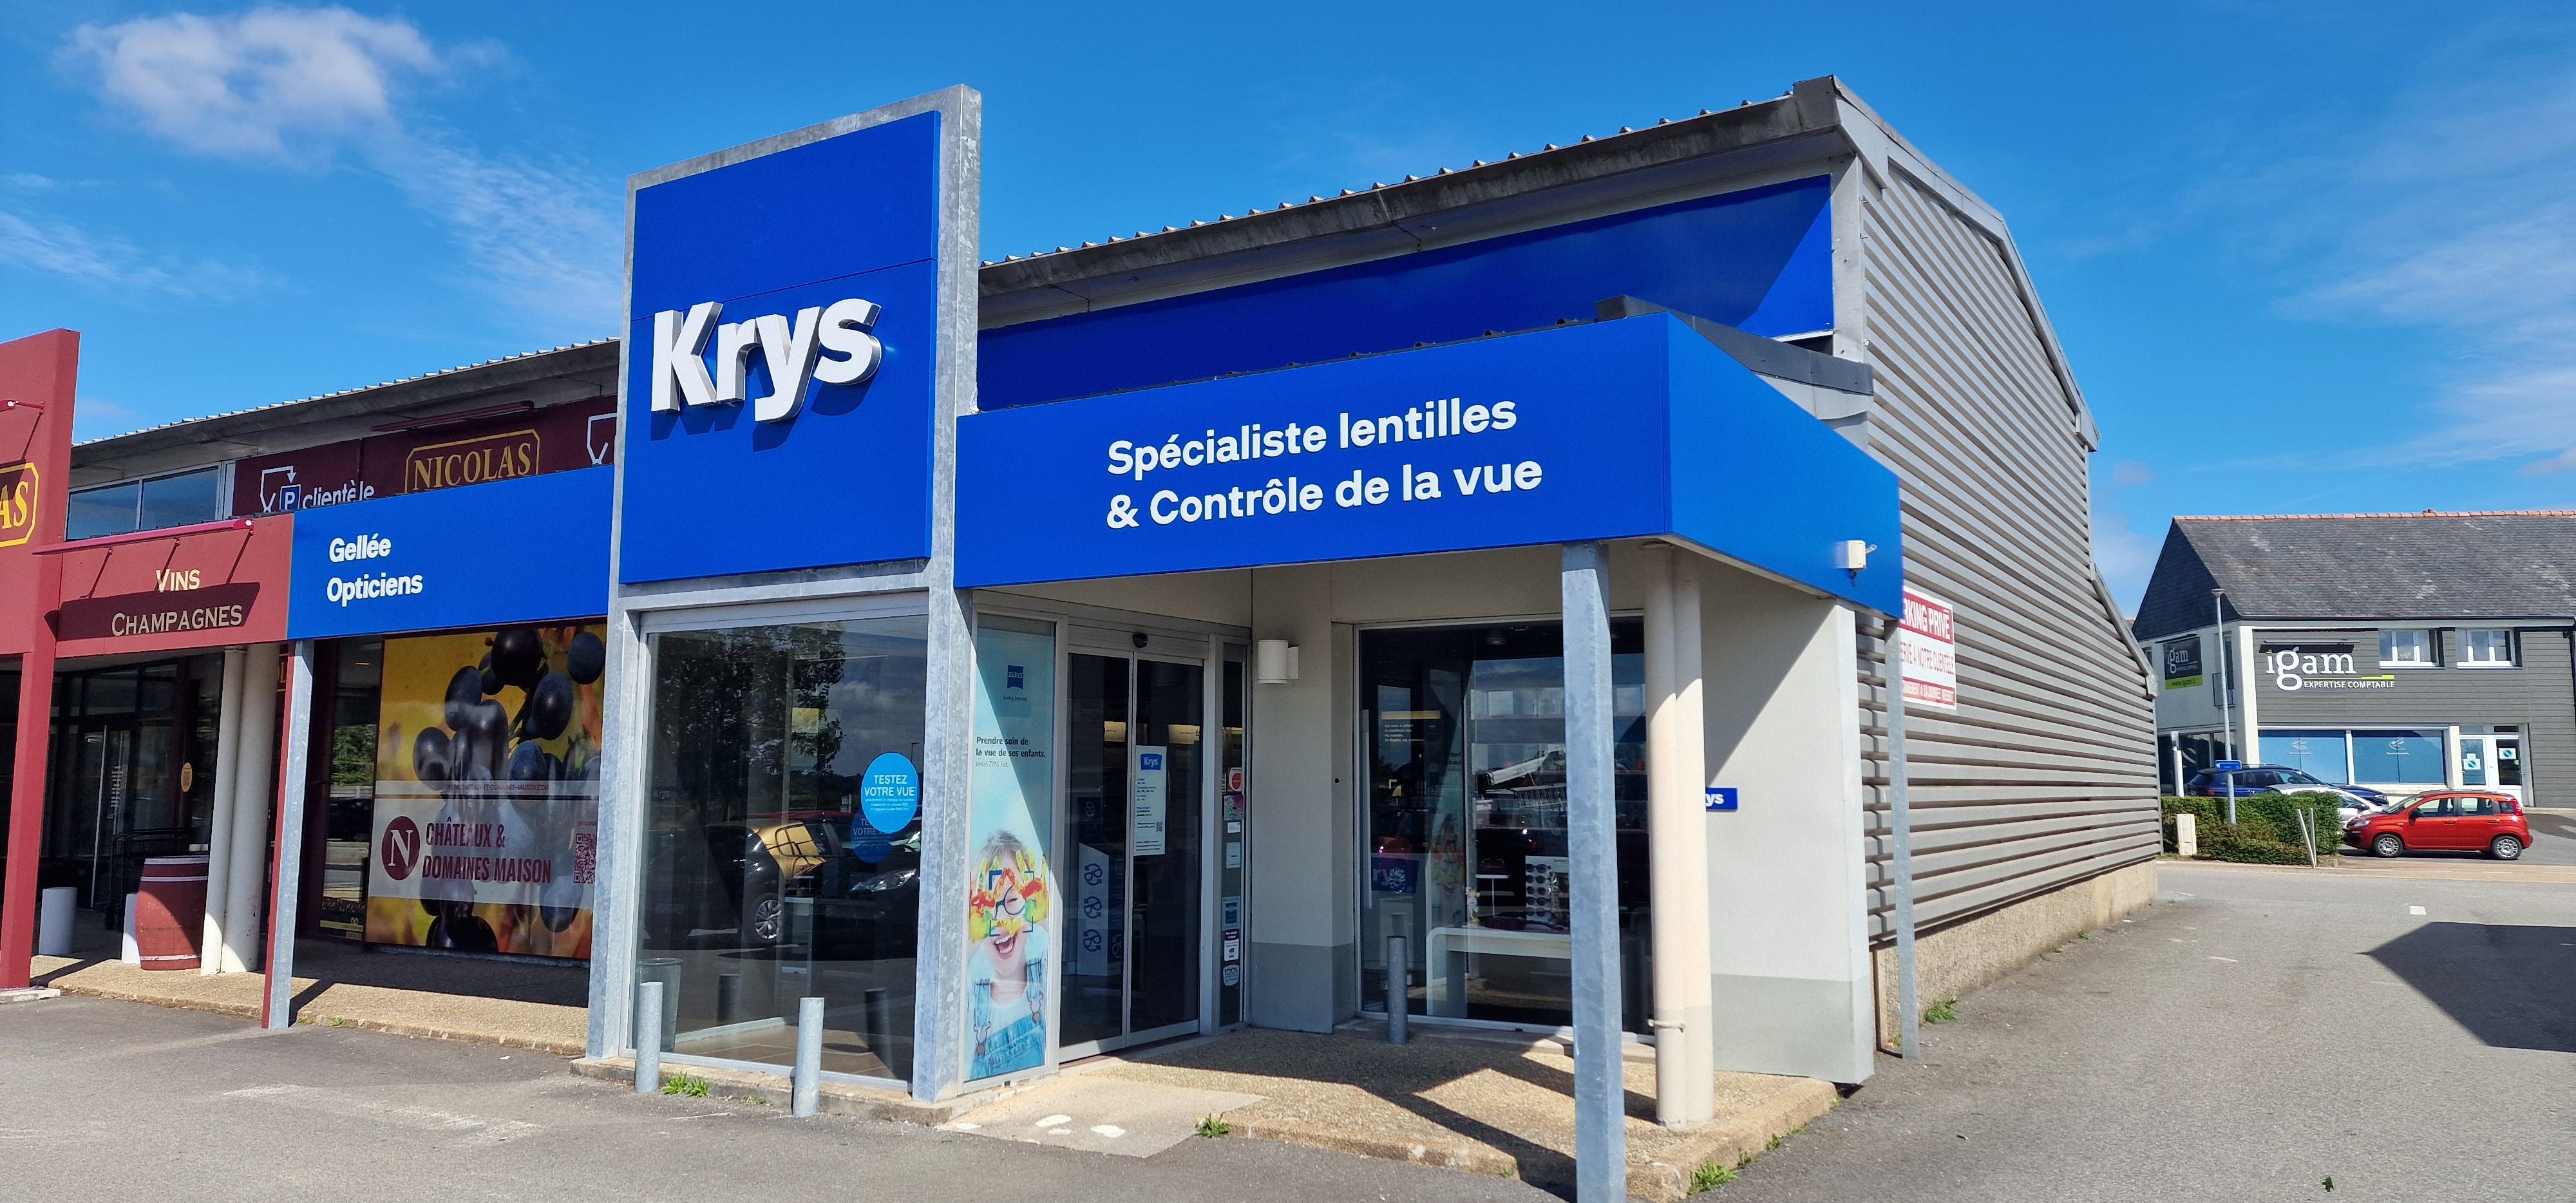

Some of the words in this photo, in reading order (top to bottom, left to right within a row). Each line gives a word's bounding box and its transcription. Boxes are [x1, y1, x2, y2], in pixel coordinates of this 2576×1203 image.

[651, 298, 882, 422] Krys
[1108, 422, 1326, 481] Spécialiste
[1340, 397, 1517, 449] lentilles
[413, 442, 531, 491] NICOLAS
[303, 480, 375, 509] clientèle
[1106, 495, 1139, 529] &
[1150, 477, 1323, 525] Contrôle
[1335, 470, 1389, 507] de
[1403, 464, 1441, 501] la
[1453, 460, 1542, 495] vue
[329, 533, 392, 563] Gellée
[327, 572, 423, 607] Opticiens
[111, 604, 242, 636] CHAMPAGNES
[2167, 647, 2188, 674] igam
[2266, 646, 2356, 690] igam
[976, 748, 982, 756] la
[1020, 749, 1046, 757] enfants.
[1144, 756, 1159, 767] Krys
[864, 786, 895, 797] VOTRE
[896, 786, 916, 797] VUE
[874, 775, 907, 784] TESTEZ
[426, 817, 491, 847] CHÂTEAUX
[496, 824, 505, 848] &
[388, 830, 413, 867] N
[422, 855, 490, 880] DOMAINES
[494, 858, 551, 883] MAISON
